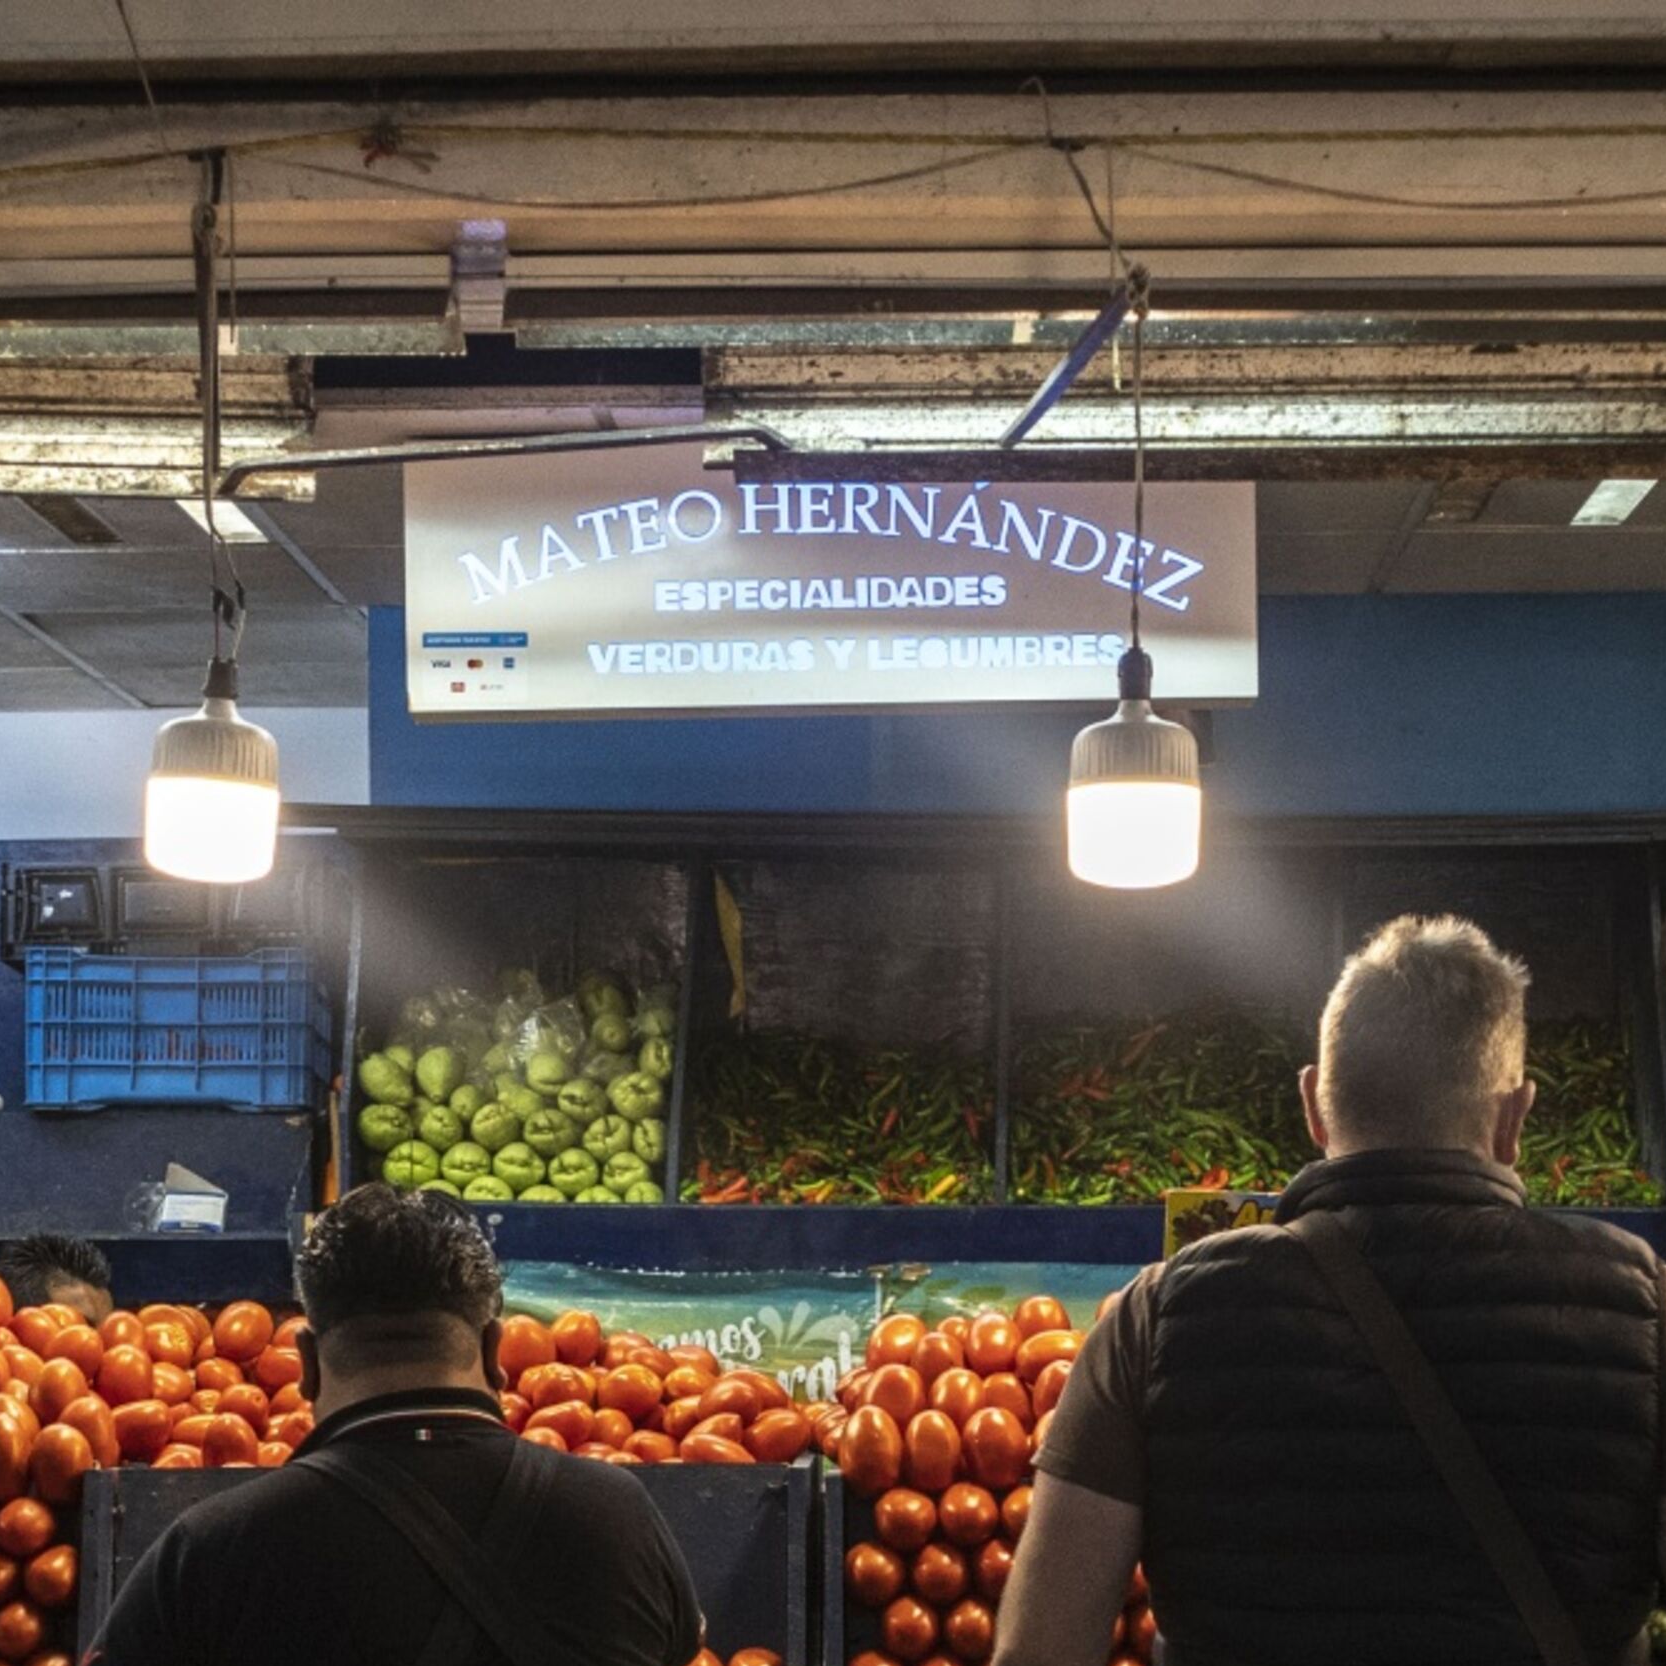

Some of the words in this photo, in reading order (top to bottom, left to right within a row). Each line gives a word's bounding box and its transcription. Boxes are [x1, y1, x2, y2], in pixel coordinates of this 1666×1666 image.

[458, 488, 724, 606] MATEO
[739, 480, 1206, 612] HERNÁNDEZ
[654, 575, 1008, 612] ESPECIALIDADES
[587, 636, 816, 675] VERDURAS
[831, 636, 857, 671] Y
[868, 633, 1126, 672] LEGUMBRES
